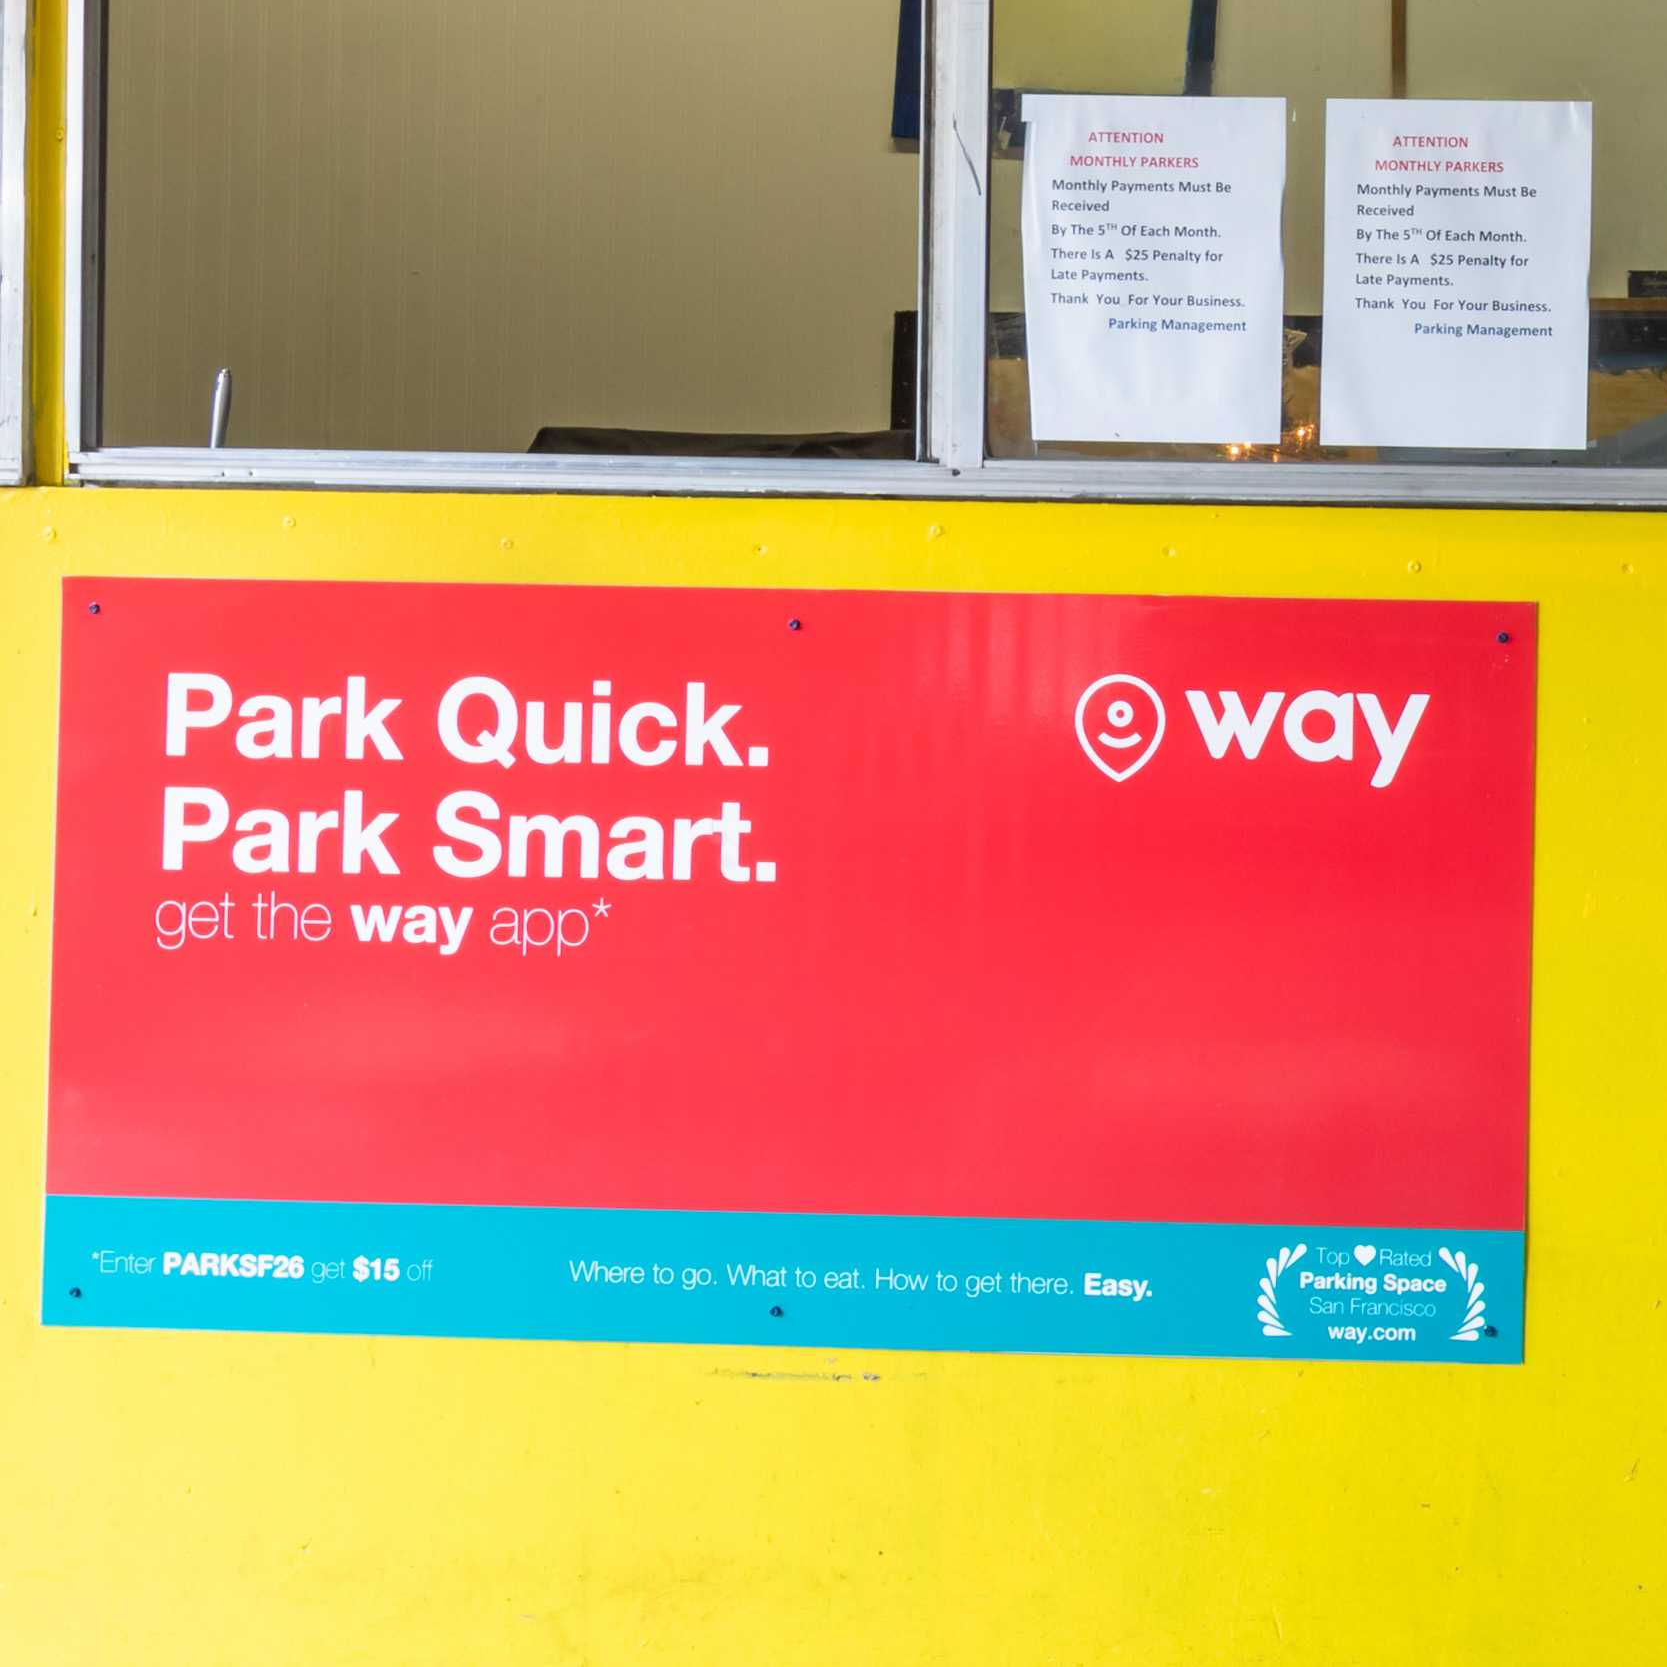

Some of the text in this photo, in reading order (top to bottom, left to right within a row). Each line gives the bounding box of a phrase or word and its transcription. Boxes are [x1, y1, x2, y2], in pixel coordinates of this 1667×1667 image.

[1089, 132, 1163, 143] ATTENTION
[1393, 136, 1468, 148] ATTENTION
[1070, 156, 1199, 168] MONTHLY PARKERS
[1376, 160, 1504, 172] MONTHLY PARKERS
[1052, 180, 1231, 193] Monthly Payments Must Be
[1052, 200, 1109, 211] Received
[1052, 224, 1066, 236] By
[1071, 224, 1094, 235] The
[1121, 225, 1137, 236] Of
[1141, 225, 1170, 236] Each
[1175, 226, 1221, 237] Month.
[1051, 248, 1223, 263] There Is A $25 Penalty for
[1051, 269, 1149, 282] Late Payments.
[1051, 293, 1245, 307] Thank You For Your Business.
[1109, 318, 1246, 333] Parking Management
[1415, 323, 1552, 338] Parking Management
[166, 673, 768, 769] Park Quick.
[1185, 690, 1430, 788] way
[162, 786, 776, 882] Park Smart.
[156, 892, 235, 950] get
[252, 891, 332, 941] the
[350, 905, 473, 955] way
[1316, 1247, 1431, 1267] Top Rated
[164, 1252, 304, 1278] PARKSF26
[312, 1261, 344, 1283] get
[353, 1255, 400, 1282] $15
[407, 1260, 432, 1280] off
[569, 1260, 1152, 1302] Where to go. What to eat. How to get there. Easy.
[1300, 1272, 1447, 1295] Parking Space
[1309, 1296, 1436, 1317] San Francisco
[1328, 1326, 1416, 1344] way.com
